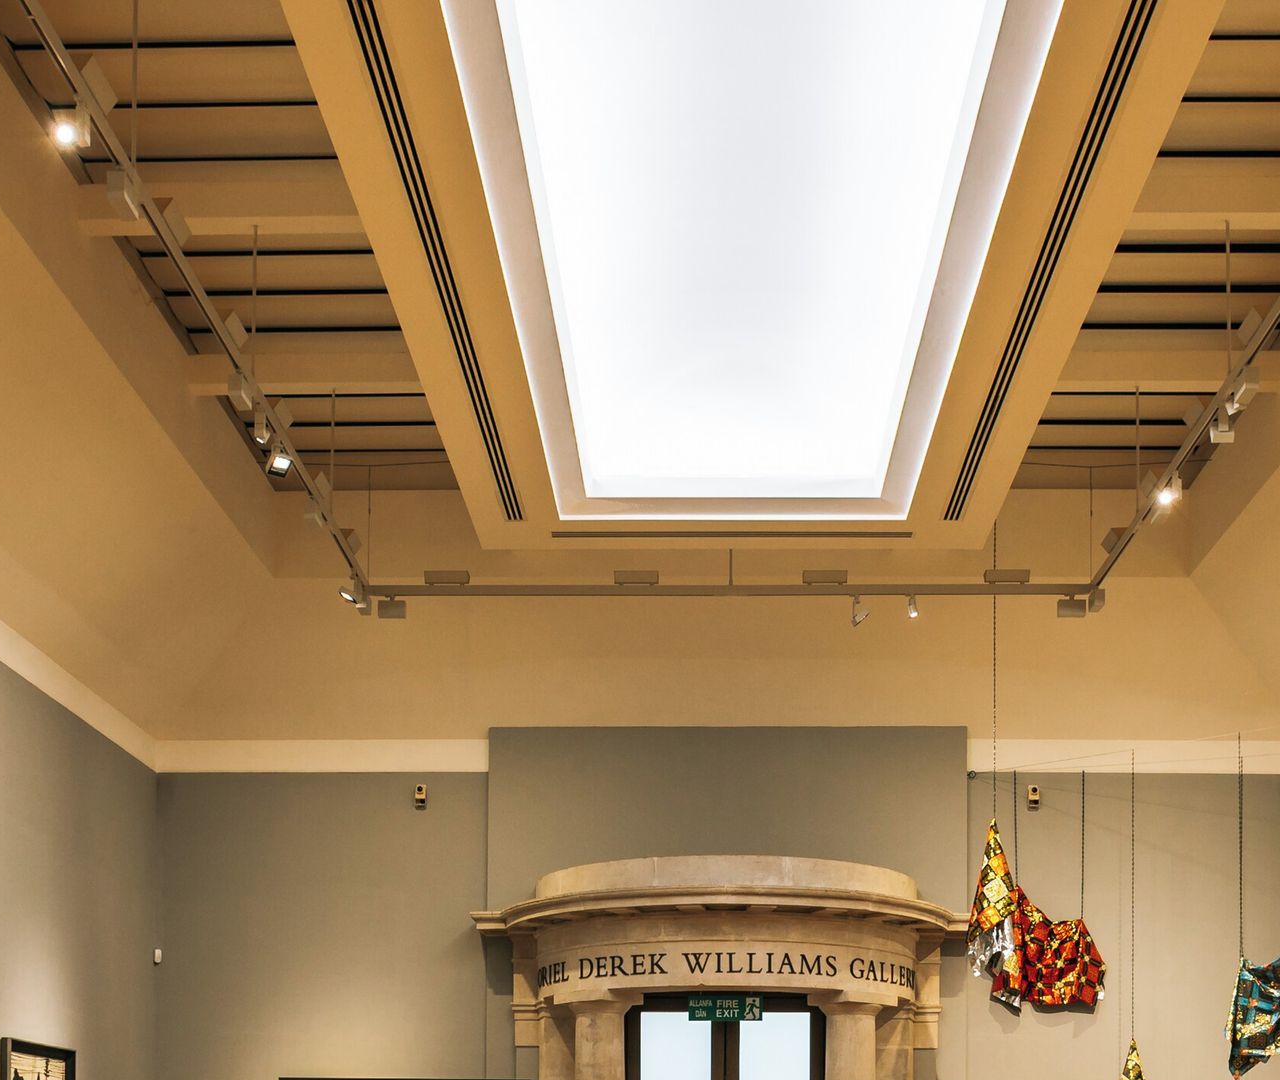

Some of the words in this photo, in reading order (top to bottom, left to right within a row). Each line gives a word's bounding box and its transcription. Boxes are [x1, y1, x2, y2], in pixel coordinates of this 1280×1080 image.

[537, 961, 570, 988] ORIEL
[578, 953, 668, 980] DEREK
[681, 952, 838, 977] WILLIAMS
[716, 1000, 739, 1008] FIRE
[716, 1009, 739, 1018] EXIT
